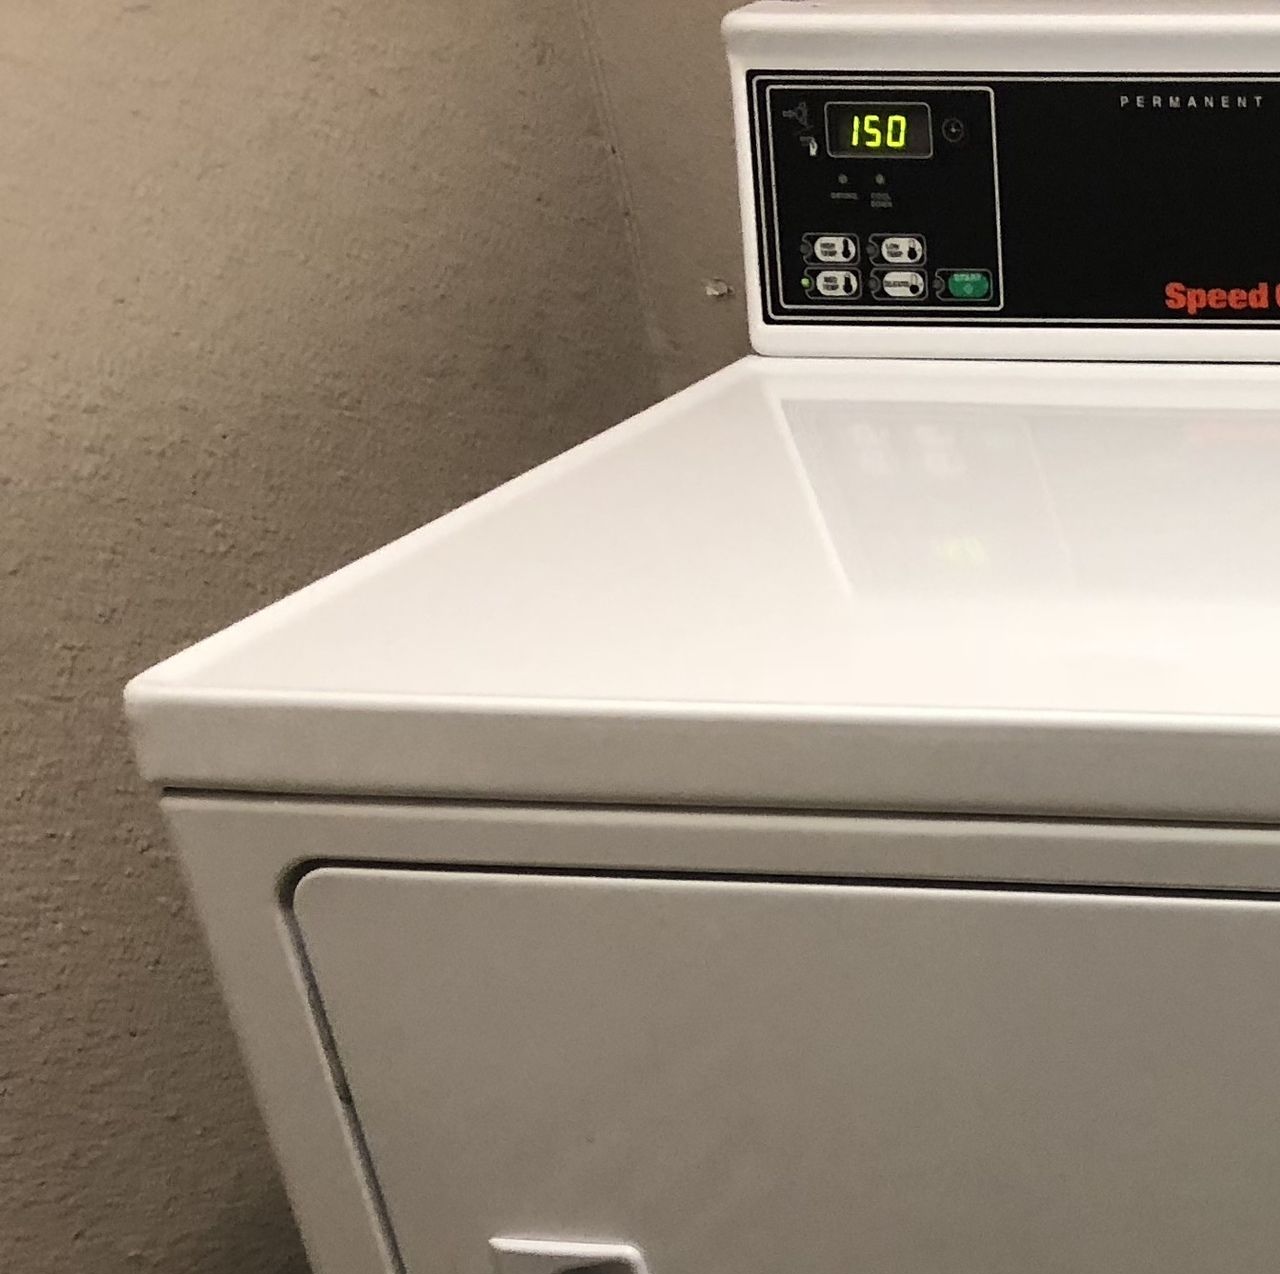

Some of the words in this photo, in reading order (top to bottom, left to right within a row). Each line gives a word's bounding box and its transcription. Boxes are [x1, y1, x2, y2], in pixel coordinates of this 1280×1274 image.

[1119, 95, 1263, 108] PERMANENT
[851, 114, 907, 149] 150
[1165, 281, 1270, 315] Speed
